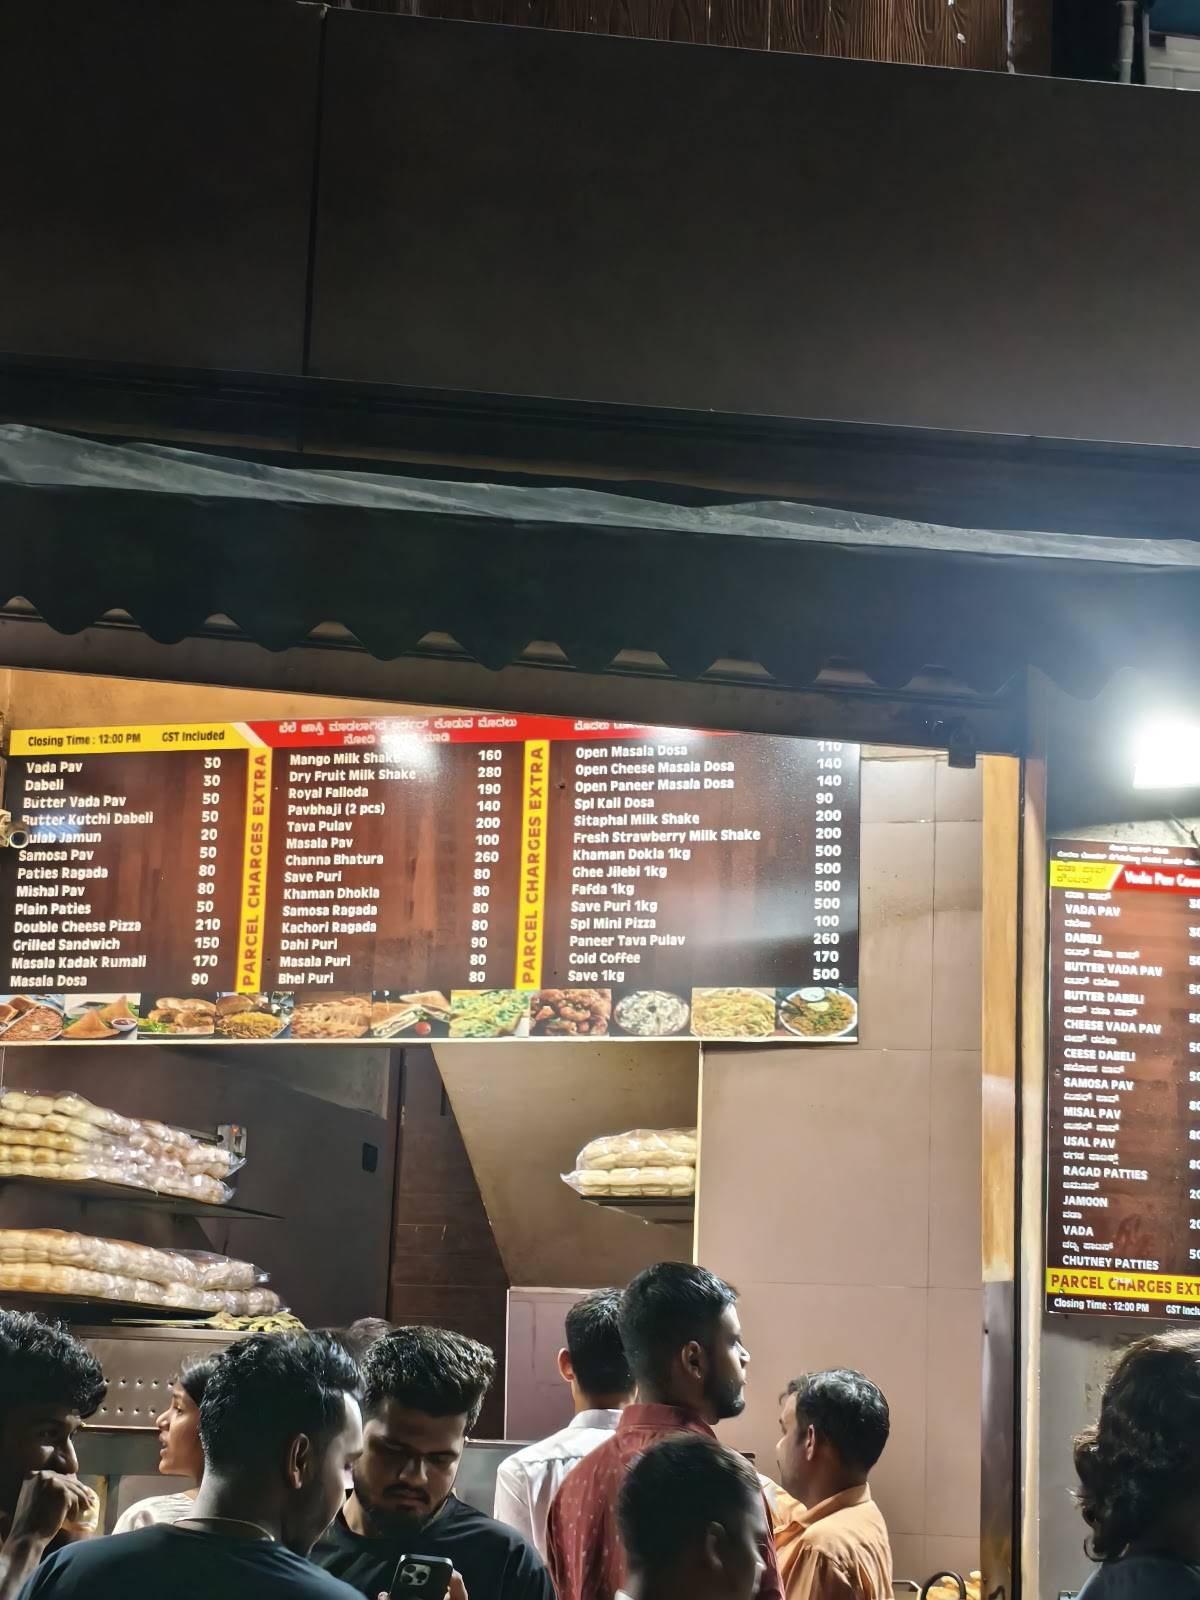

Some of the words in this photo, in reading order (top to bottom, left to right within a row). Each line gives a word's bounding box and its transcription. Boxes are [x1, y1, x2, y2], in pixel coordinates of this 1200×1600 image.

[28, 735, 63, 747] Closing
[67, 734, 91, 745] Time
[99, 733, 124, 744] 12:00
[126, 732, 141, 743] PM
[162, 731, 179, 742] GST
[182, 730, 225, 741] Included
[576, 747, 608, 760] Open
[611, 745, 654, 758] Masala
[658, 745, 687, 756] Dosa
[26, 761, 56, 773] Vada
[59, 761, 83, 772] Pav
[204, 756, 221, 769] 30
[290, 754, 331, 767] Mango
[334, 752, 360, 764] Milk
[575, 764, 608, 777] Open
[610, 763, 655, 774] Cheese
[658, 761, 700, 773] Masala
[704, 761, 734, 772] Dosa
[289, 771, 311, 783] Dry
[314, 769, 346, 782] Fruit
[349, 769, 375, 781] Milk
[379, 769, 415, 780] Shake
[529, 746, 544, 811] EXTRA
[25, 778, 64, 791] Dabeli
[252, 754, 267, 815] EXTRA
[575, 781, 608, 794] Open
[610, 780, 655, 791] Paneer
[658, 778, 700, 790] Masala
[704, 778, 734, 789] Dosa
[288, 787, 322, 800] Royal
[23, 796, 66, 808] Butter
[69, 795, 100, 808] Vada
[103, 795, 126, 806] Pav
[575, 798, 594, 811] Spl
[624, 797, 654, 808] Dosa
[288, 803, 342, 816] Pavbhaji
[345, 803, 357, 816] (2
[360, 802, 385, 815] pcs)
[68, 812, 110, 825] Kutchi
[114, 811, 153, 825] Dabeli
[574, 814, 627, 828] Sitaphal
[631, 813, 658, 825] Milk
[661, 813, 699, 824] Shake
[287, 821, 316, 832] Tava
[318, 820, 352, 832] Pulav
[27, 832, 56, 844] ulab
[59, 832, 102, 843] Jamun
[574, 832, 609, 843] Fresh
[612, 830, 686, 843] Strawberry
[689, 829, 717, 841] Milk
[721, 829, 761, 841] Shake
[286, 837, 328, 849] Masala
[331, 837, 353, 848] Pav
[19, 848, 67, 861] Samosa
[71, 849, 94, 860] Pav
[285, 854, 331, 866] Channa
[333, 853, 383, 865] Bhatura
[573, 849, 625, 860] Khaman
[628, 848, 664, 860] Dokla
[668, 847, 691, 860] 1kg
[247, 822, 263, 908] CHARGES
[525, 817, 541, 904] CHARGES
[18, 866, 58, 879] Paties
[60, 866, 108, 880] Ragada
[284, 871, 313, 883] Save
[315, 870, 342, 882] Puri
[573, 866, 604, 878] Ghee
[606, 865, 640, 877] Jilebi
[644, 865, 667, 878] 1kg
[16, 884, 59, 897] Mishal
[61, 885, 85, 896] Pav
[283, 888, 334, 900] Khaman
[336, 887, 380, 899] Dhokla
[572, 883, 607, 895] Fafda
[611, 883, 634, 896] 1kg
[15, 903, 48, 915] Plain
[50, 902, 91, 915] Paties
[282, 905, 330, 917] Samosa
[332, 904, 377, 917] Ragada
[571, 901, 601, 912] Save
[604, 900, 631, 912] Puri
[634, 900, 657, 913] 1kg
[1065, 904, 1097, 915] VADA
[1098, 906, 1121, 917] PAV
[14, 921, 58, 933] Double
[61, 920, 106, 933] Cheese
[109, 919, 141, 931] Pizza
[195, 918, 220, 931] 210
[282, 921, 329, 934] Kachori
[331, 921, 376, 934] Ragada
[570, 918, 590, 931] Spl
[594, 917, 622, 929] Mini
[625, 917, 656, 929] Pizza
[12, 938, 56, 951] Grilled
[58, 937, 120, 951] Sandwich
[280, 938, 309, 950] Dahi
[311, 938, 337, 950] Puri
[522, 911, 538, 983] PARCEL
[570, 936, 614, 947] Paneer
[617, 935, 646, 946] Tava
[650, 934, 685, 945] Pulav
[242, 915, 259, 986] PARCEL
[12, 957, 58, 969] Masala
[59, 956, 98, 968] Kadak
[101, 955, 146, 967] Rumali
[279, 955, 321, 967] Masala
[325, 955, 350, 967] Puri
[569, 952, 596, 964] Cold
[599, 952, 640, 964] Coffee
[568, 970, 598, 981] Save
[601, 969, 624, 982] 1kg
[1064, 961, 1106, 974] BUTTER
[1107, 963, 1139, 975] VADA
[1139, 965, 1163, 977] PAV
[10, 975, 54, 987] Masala
[57, 975, 87, 986] Dosa
[278, 973, 305, 984] Bhel
[307, 972, 333, 984] Puri
[1064, 1019, 1104, 1031] CHEESE
[1105, 1021, 1137, 1033] VADA
[1138, 1023, 1162, 1034] PAV
[1064, 1077, 1110, 1090] SAMOSA
[1111, 1080, 1134, 1091] PAV
[1064, 1106, 1098, 1118] MISAL
[1098, 1108, 1121, 1120] PAV
[1064, 1136, 1092, 1147] USAL
[1093, 1138, 1116, 1149] PAV
[1063, 1165, 1102, 1177] RAGAD
[1103, 1168, 1149, 1180] PATTIES
[1063, 1195, 1109, 1207] JAMOON
[1063, 1225, 1094, 1237] VADA
[1062, 1255, 1113, 1268] CHUTNEY
[1115, 1258, 1160, 1271] PATTIES
[1051, 1273, 1104, 1290] PARCEL
[1108, 1277, 1172, 1294] CHARGES
[1054, 1298, 1085, 1310] Closing
[1087, 1300, 1108, 1310] Time
[1113, 1301, 1135, 1312] 12:00
[1136, 1302, 1149, 1312] PM
[1166, 1304, 1181, 1315] GST
